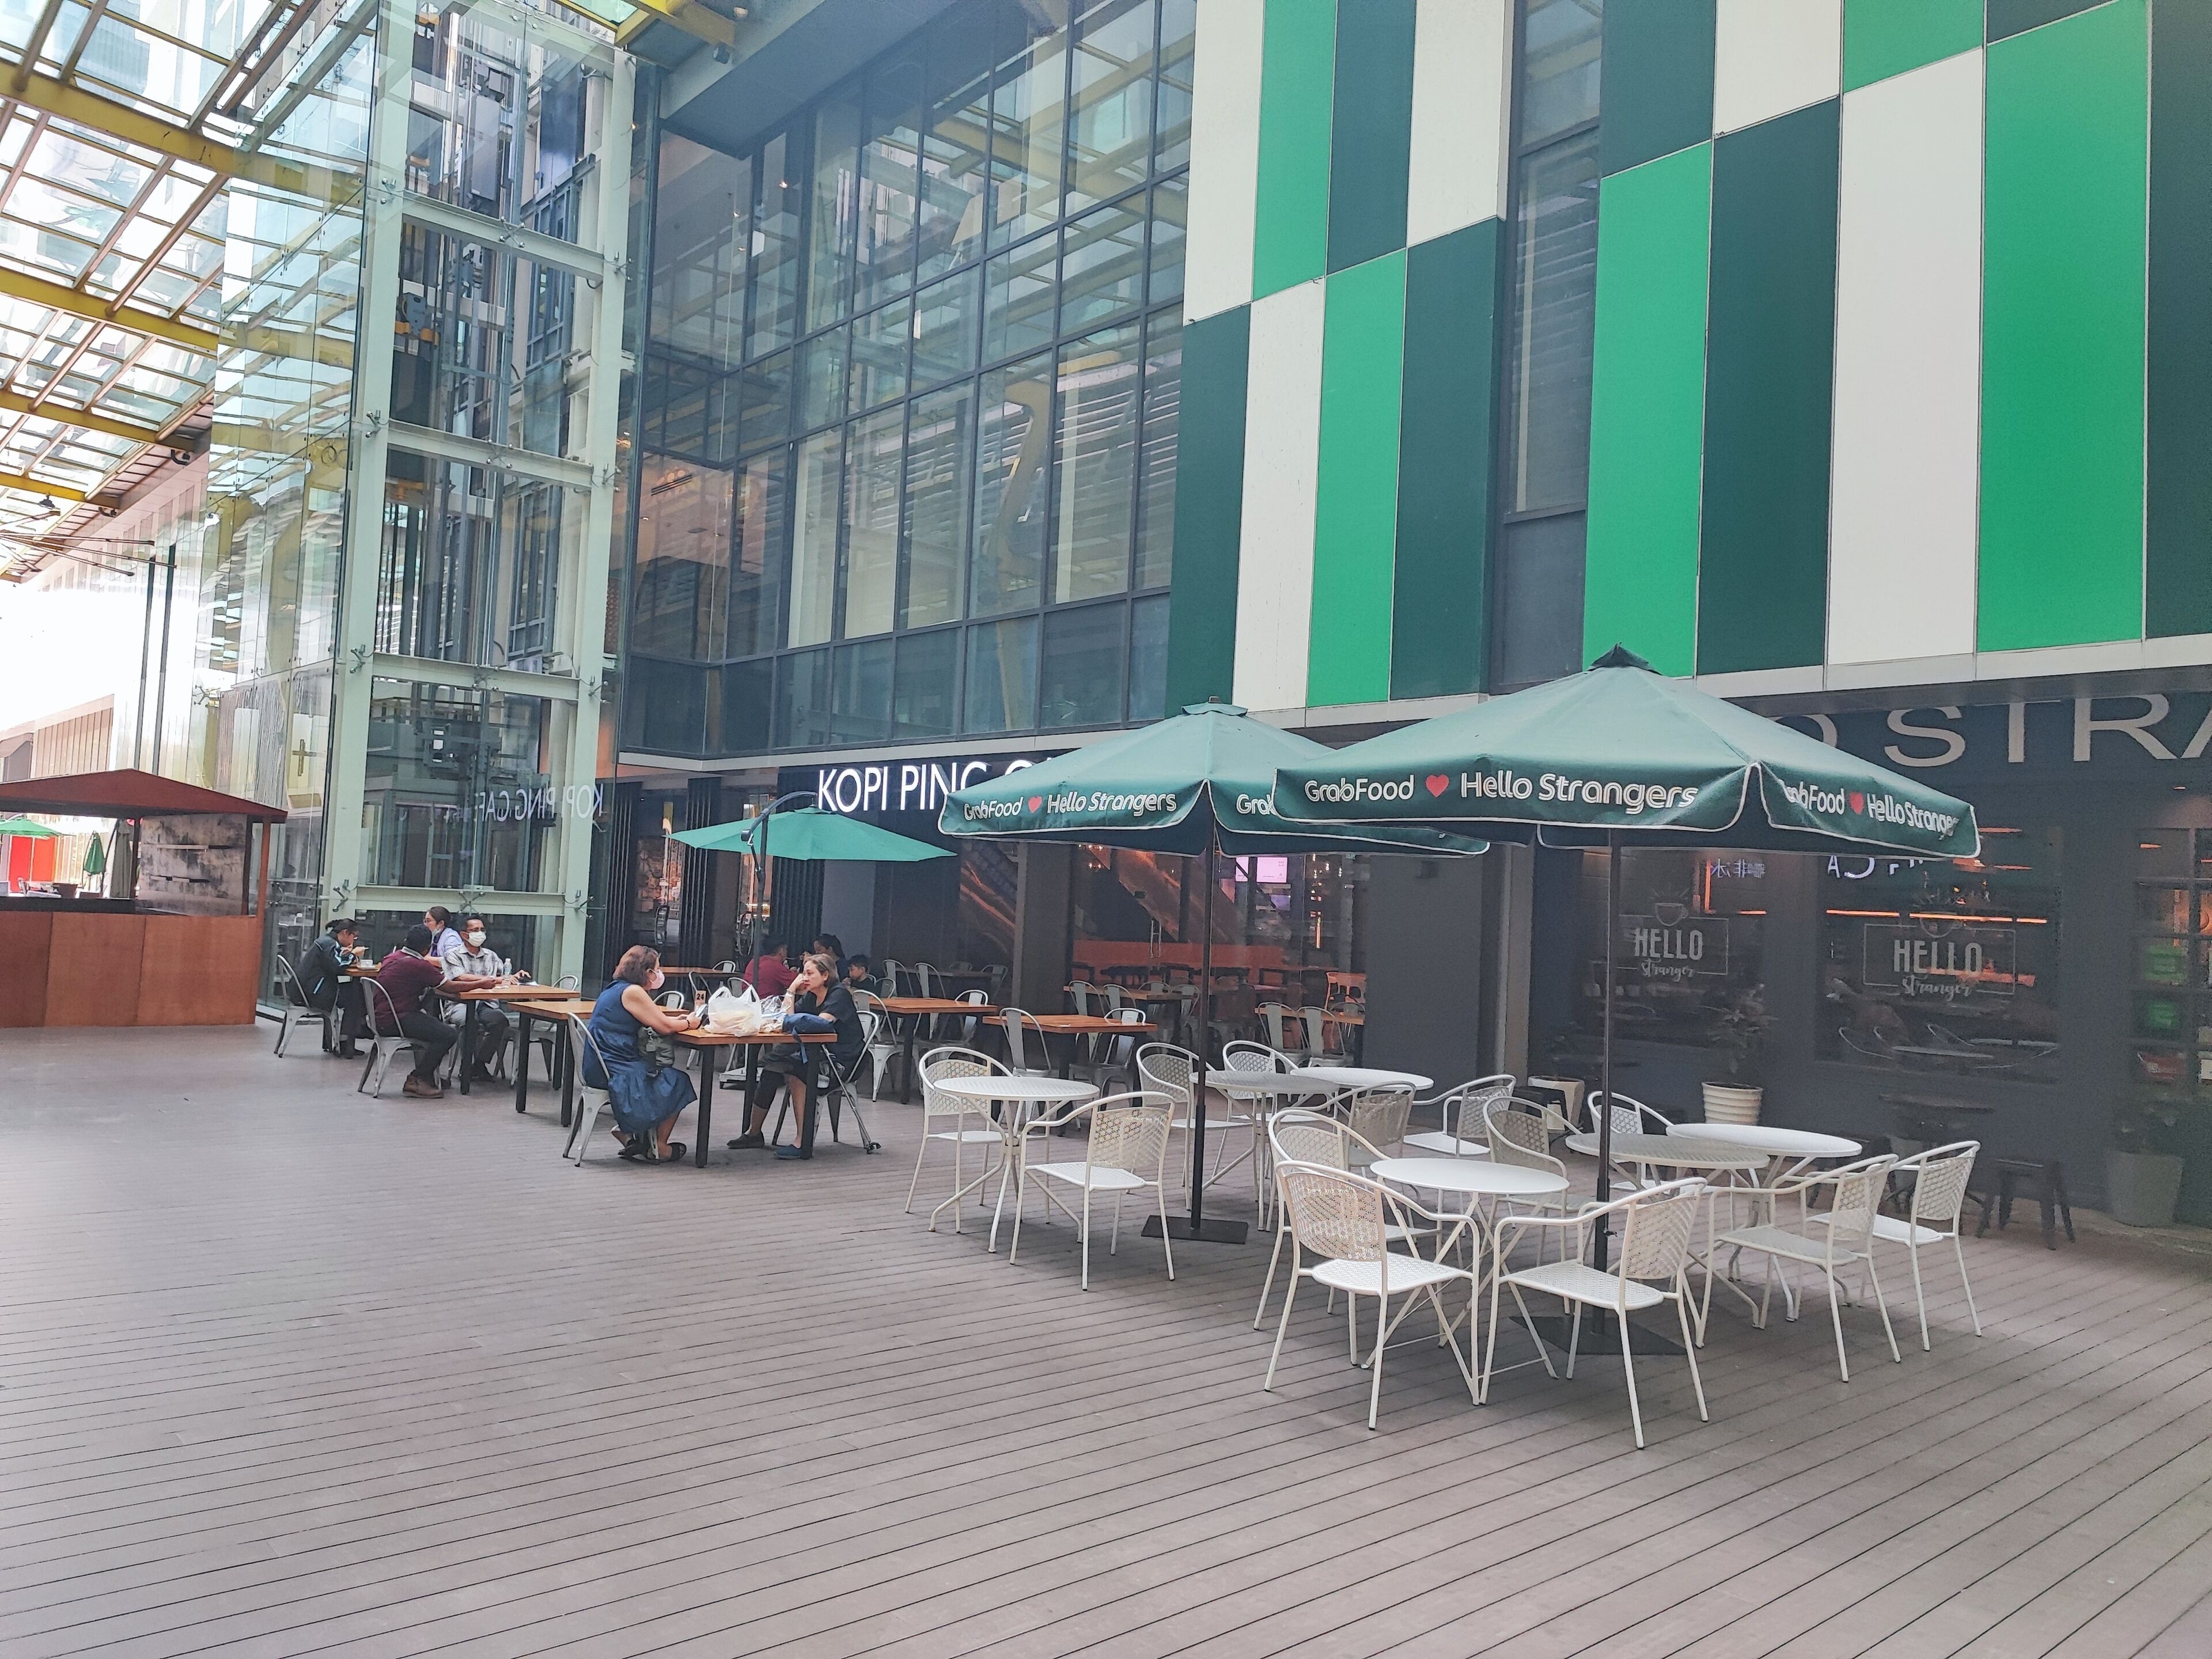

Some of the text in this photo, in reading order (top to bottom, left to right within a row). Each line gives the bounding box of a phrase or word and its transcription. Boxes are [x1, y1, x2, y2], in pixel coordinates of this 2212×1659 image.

[1884, 694, 2212, 767] STR
[818, 766, 889, 813] KOPI
[964, 791, 1177, 820] GrabFood Hello Strangers
[1305, 770, 1698, 815] GrabFood Hello Strangers
[1867, 793, 1906, 824] Hello
[1634, 928, 1703, 960] HELLO
[1893, 940, 1982, 977] HELLO
